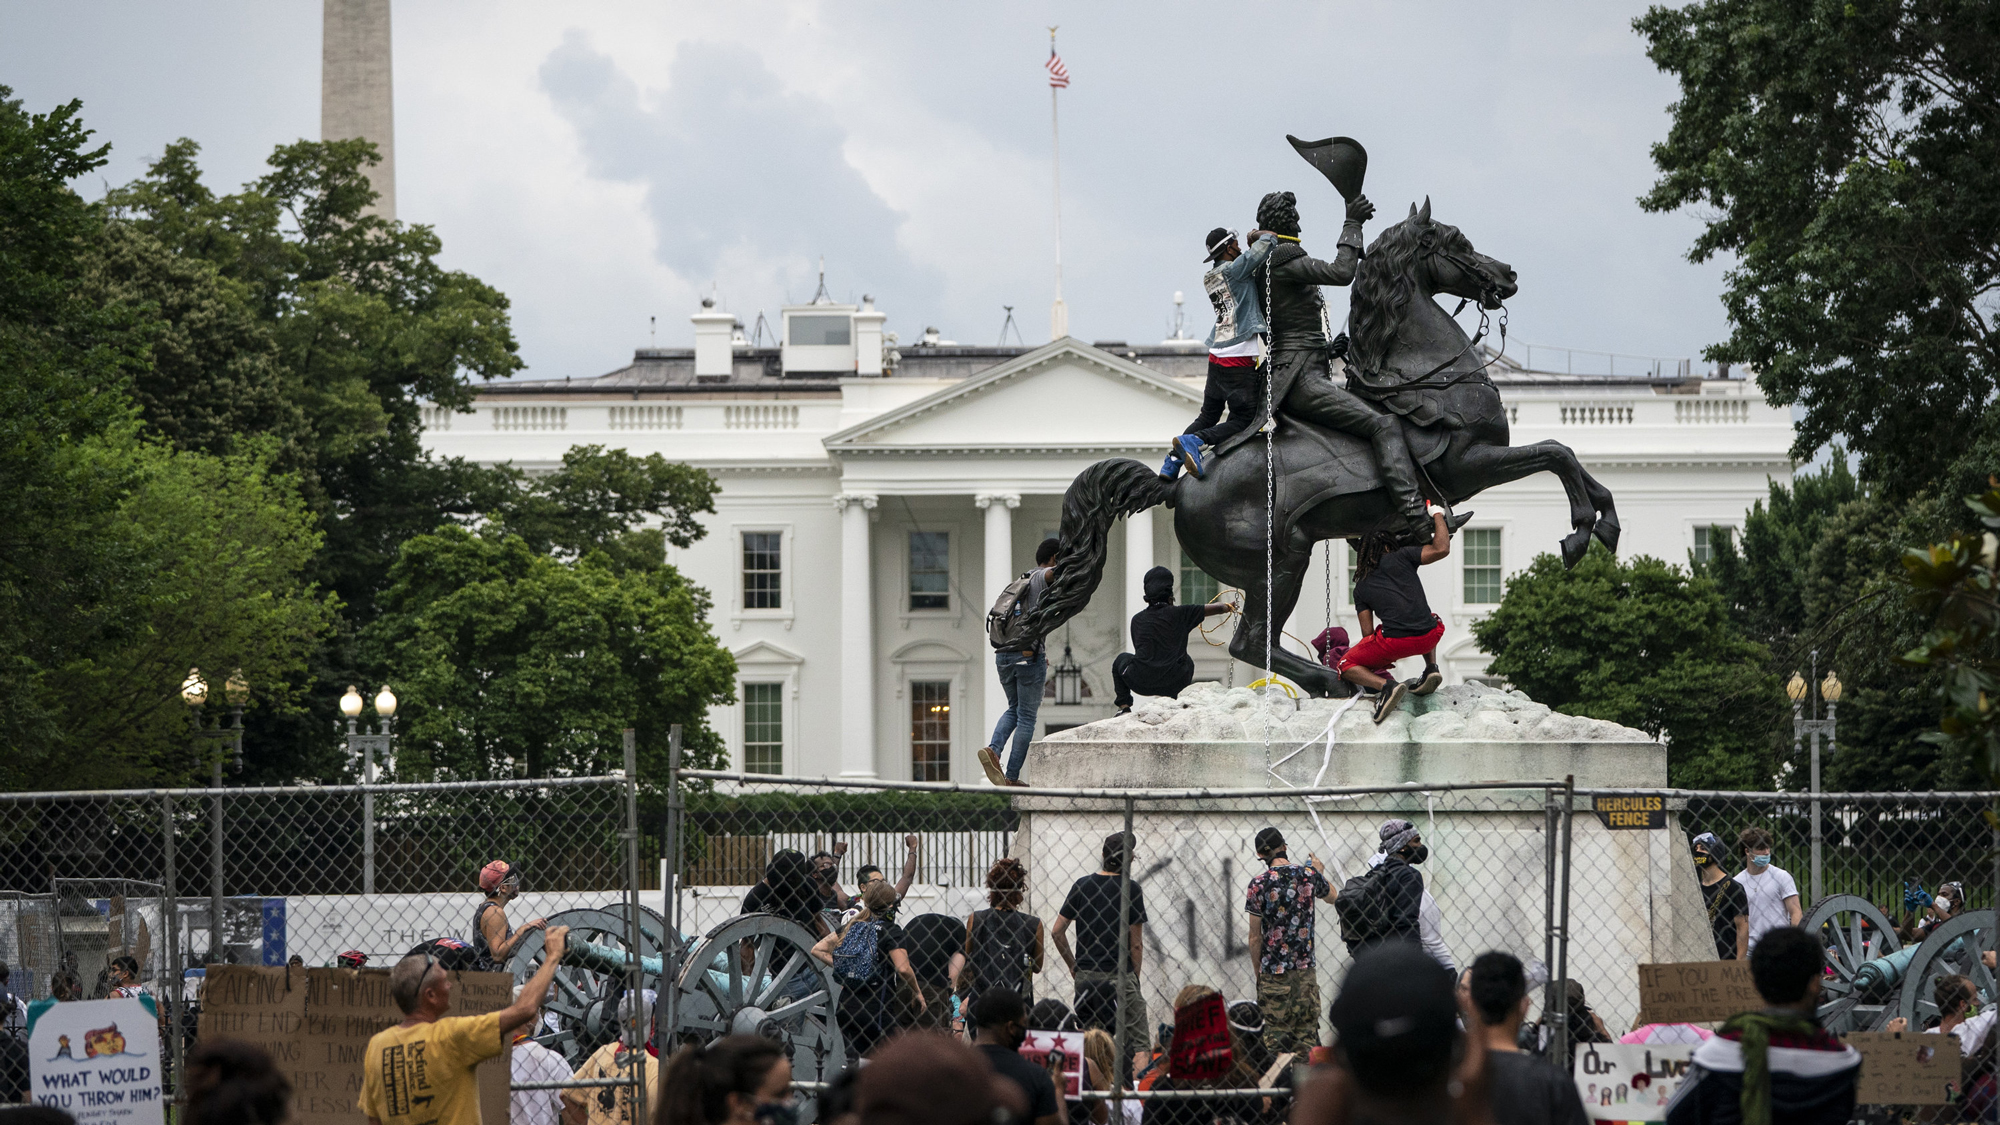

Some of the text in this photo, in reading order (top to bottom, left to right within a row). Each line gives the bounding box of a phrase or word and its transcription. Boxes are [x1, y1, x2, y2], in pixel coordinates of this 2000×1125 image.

[1597, 797, 1662, 811] HERCULES
[1609, 812, 1650, 826] FENCE
[383, 929, 433, 943] THE
[1644, 967, 1666, 987] IF
[1676, 966, 1709, 987] YOU
[1692, 987, 1721, 1004] THE
[214, 1011, 250, 1032] HELP
[258, 1010, 302, 1034] END
[415, 1040, 432, 1091] Defund
[1583, 1050, 1617, 1075] Our
[42, 1066, 151, 1089] WHAT WOULD
[38, 1086, 161, 1108] YOU THROW HIM?
